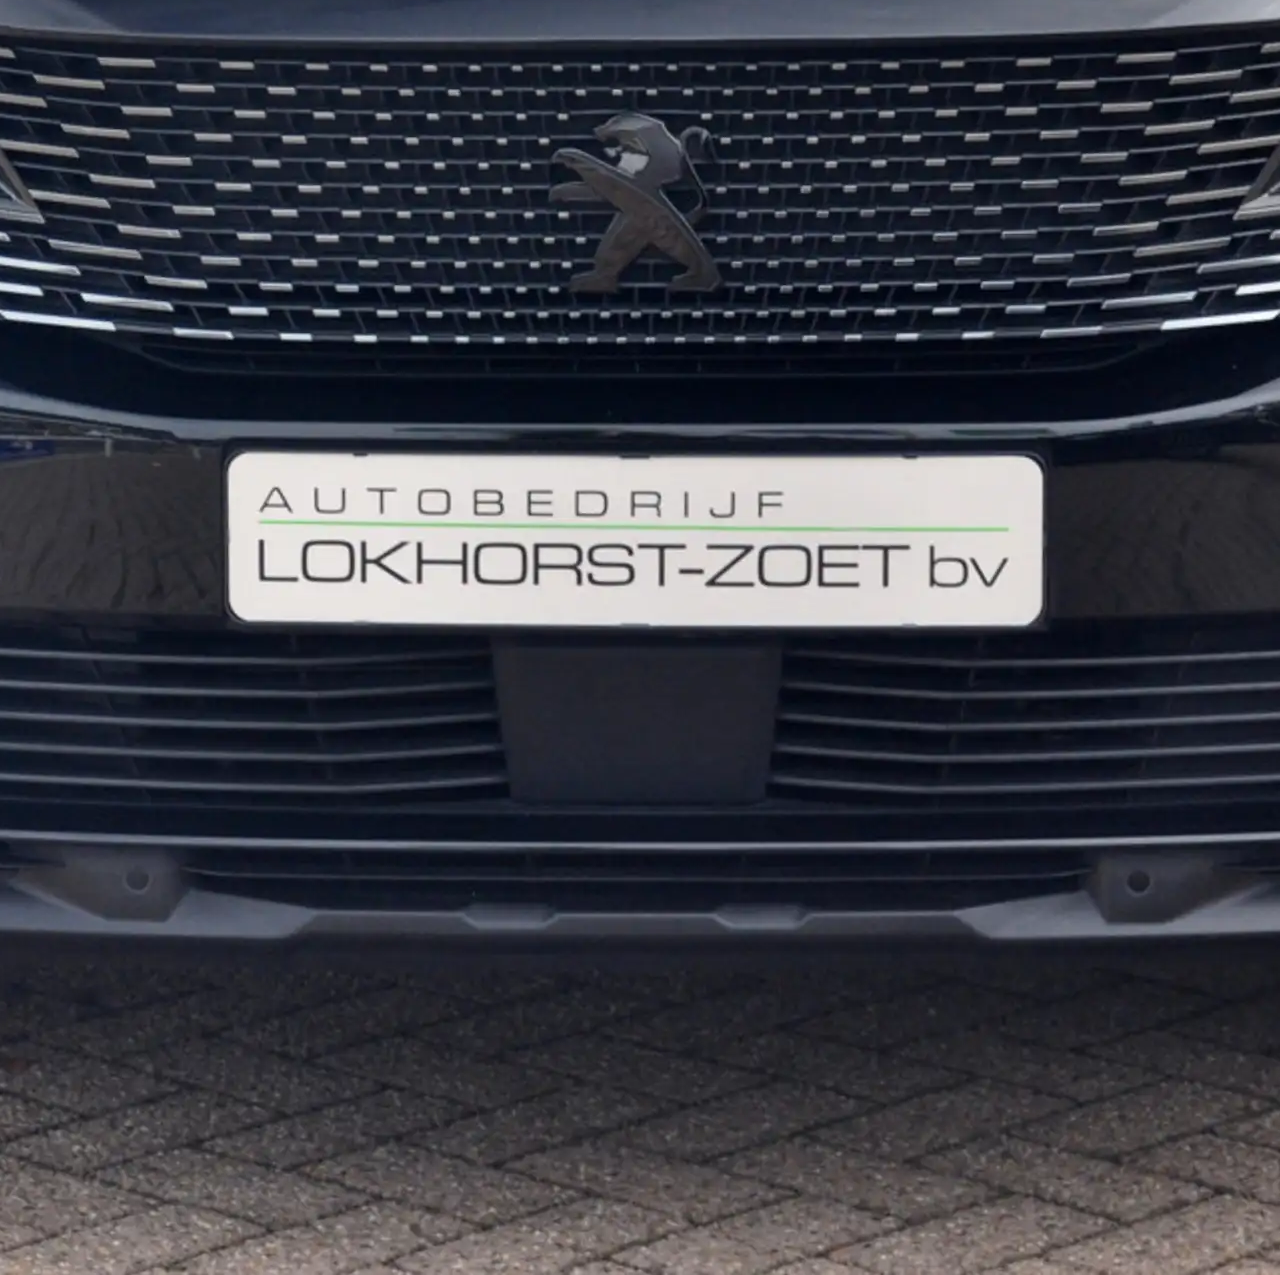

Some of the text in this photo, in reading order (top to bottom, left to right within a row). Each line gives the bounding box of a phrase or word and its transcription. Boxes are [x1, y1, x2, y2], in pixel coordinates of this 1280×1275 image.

[259, 486, 787, 519] AUTOBEDRIJF
[258, 539, 1010, 589] LOKHORST-ZOET bv
